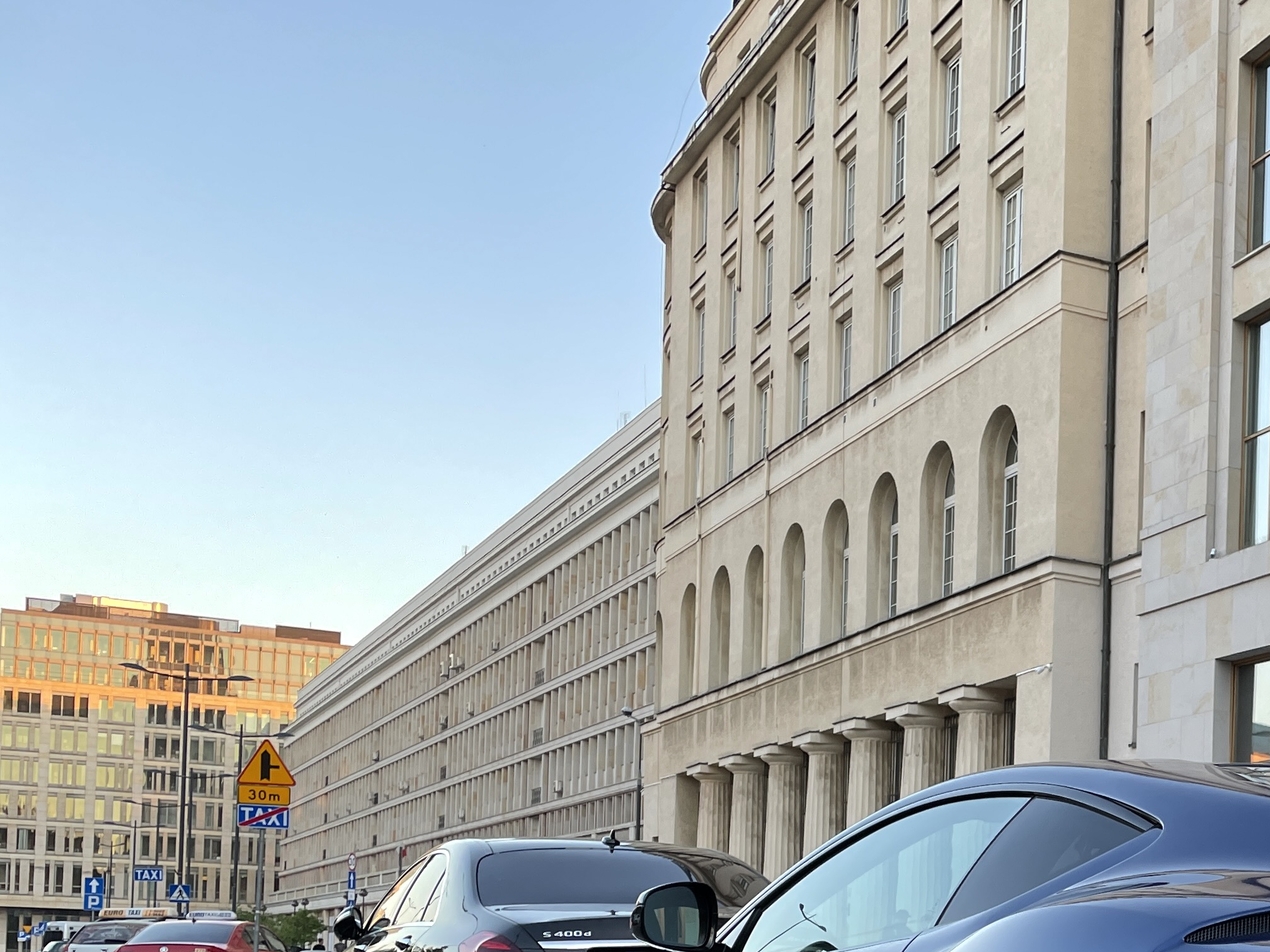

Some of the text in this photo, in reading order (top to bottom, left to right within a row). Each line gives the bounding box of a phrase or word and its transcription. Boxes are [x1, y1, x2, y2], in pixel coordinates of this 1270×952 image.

[248, 789, 280, 802] 30 m
[240, 806, 288, 827] TAXI
[135, 869, 163, 880] TAXI
[88, 895, 100, 909] P
[554, 930, 592, 938] 400d
